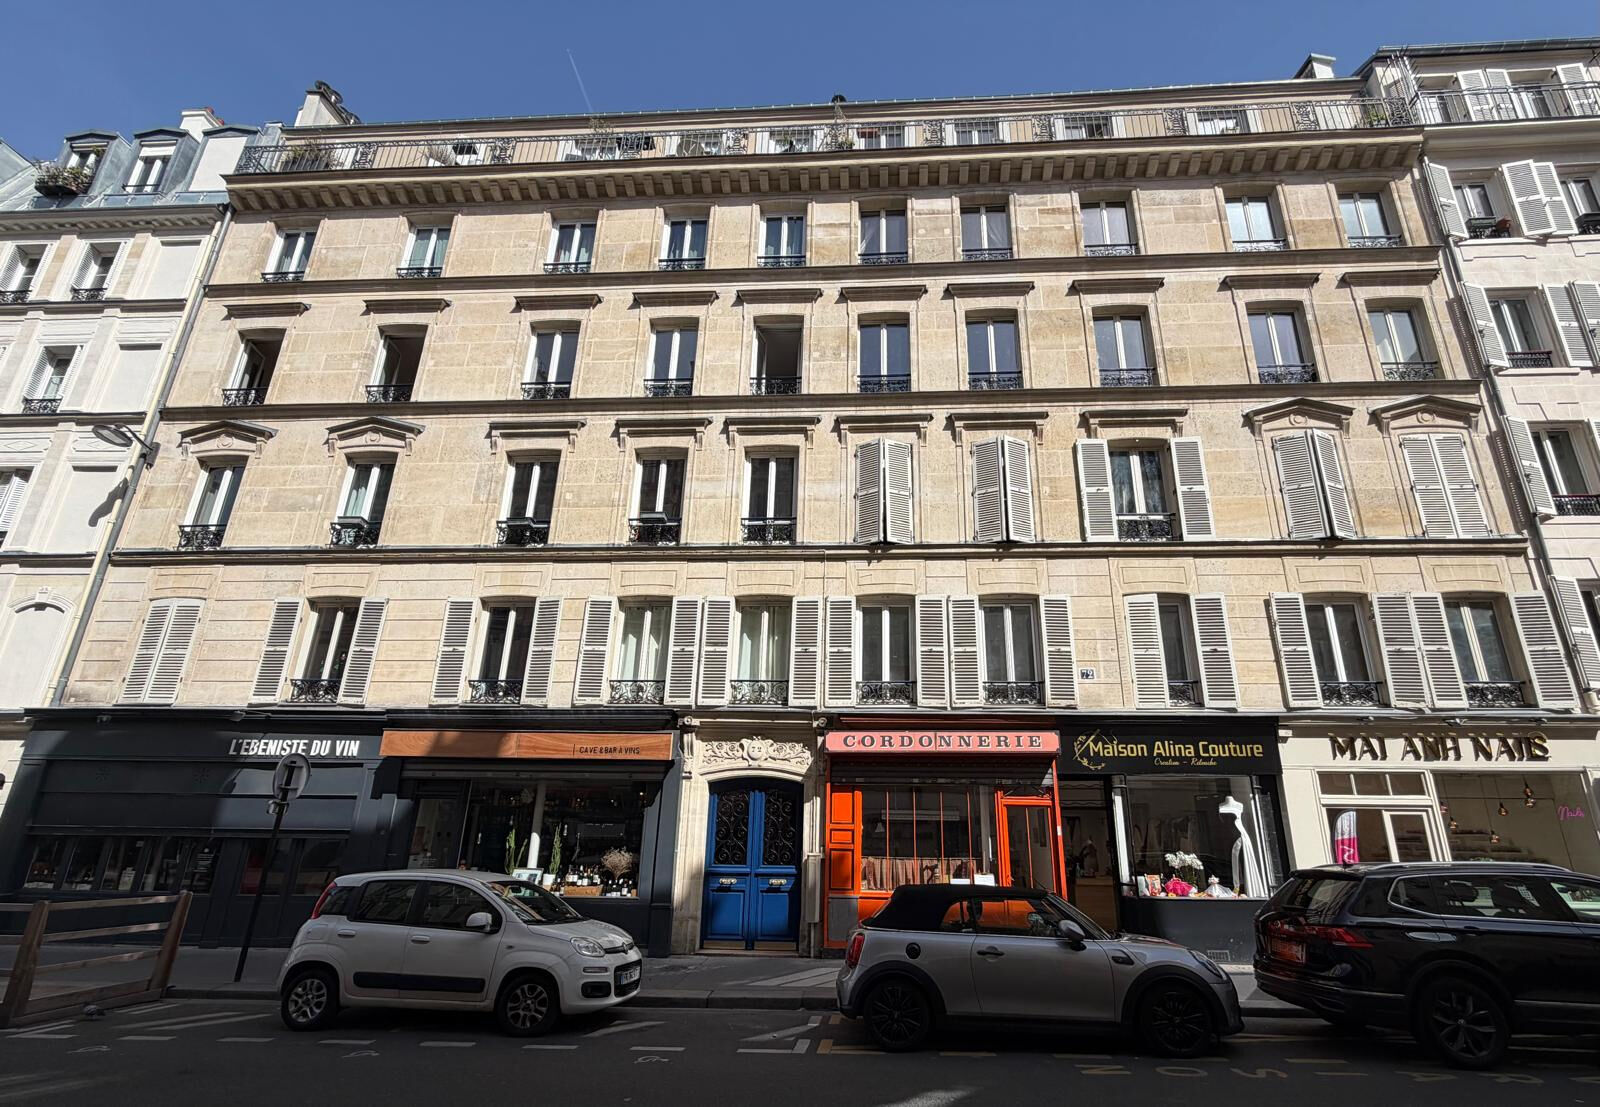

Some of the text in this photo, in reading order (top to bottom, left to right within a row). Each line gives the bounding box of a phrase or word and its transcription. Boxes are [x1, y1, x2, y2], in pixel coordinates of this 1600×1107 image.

[1081, 669, 1095, 679] 72
[310, 739, 331, 757] DU
[335, 739, 361, 757] VIN
[843, 734, 1043, 749] CORDONNERIE
[1089, 740, 1264, 757] Maison Alina Couture
[1328, 732, 1388, 761] MAI
[579, 746, 598, 754] CAVE
[624, 746, 641, 755] VINS
